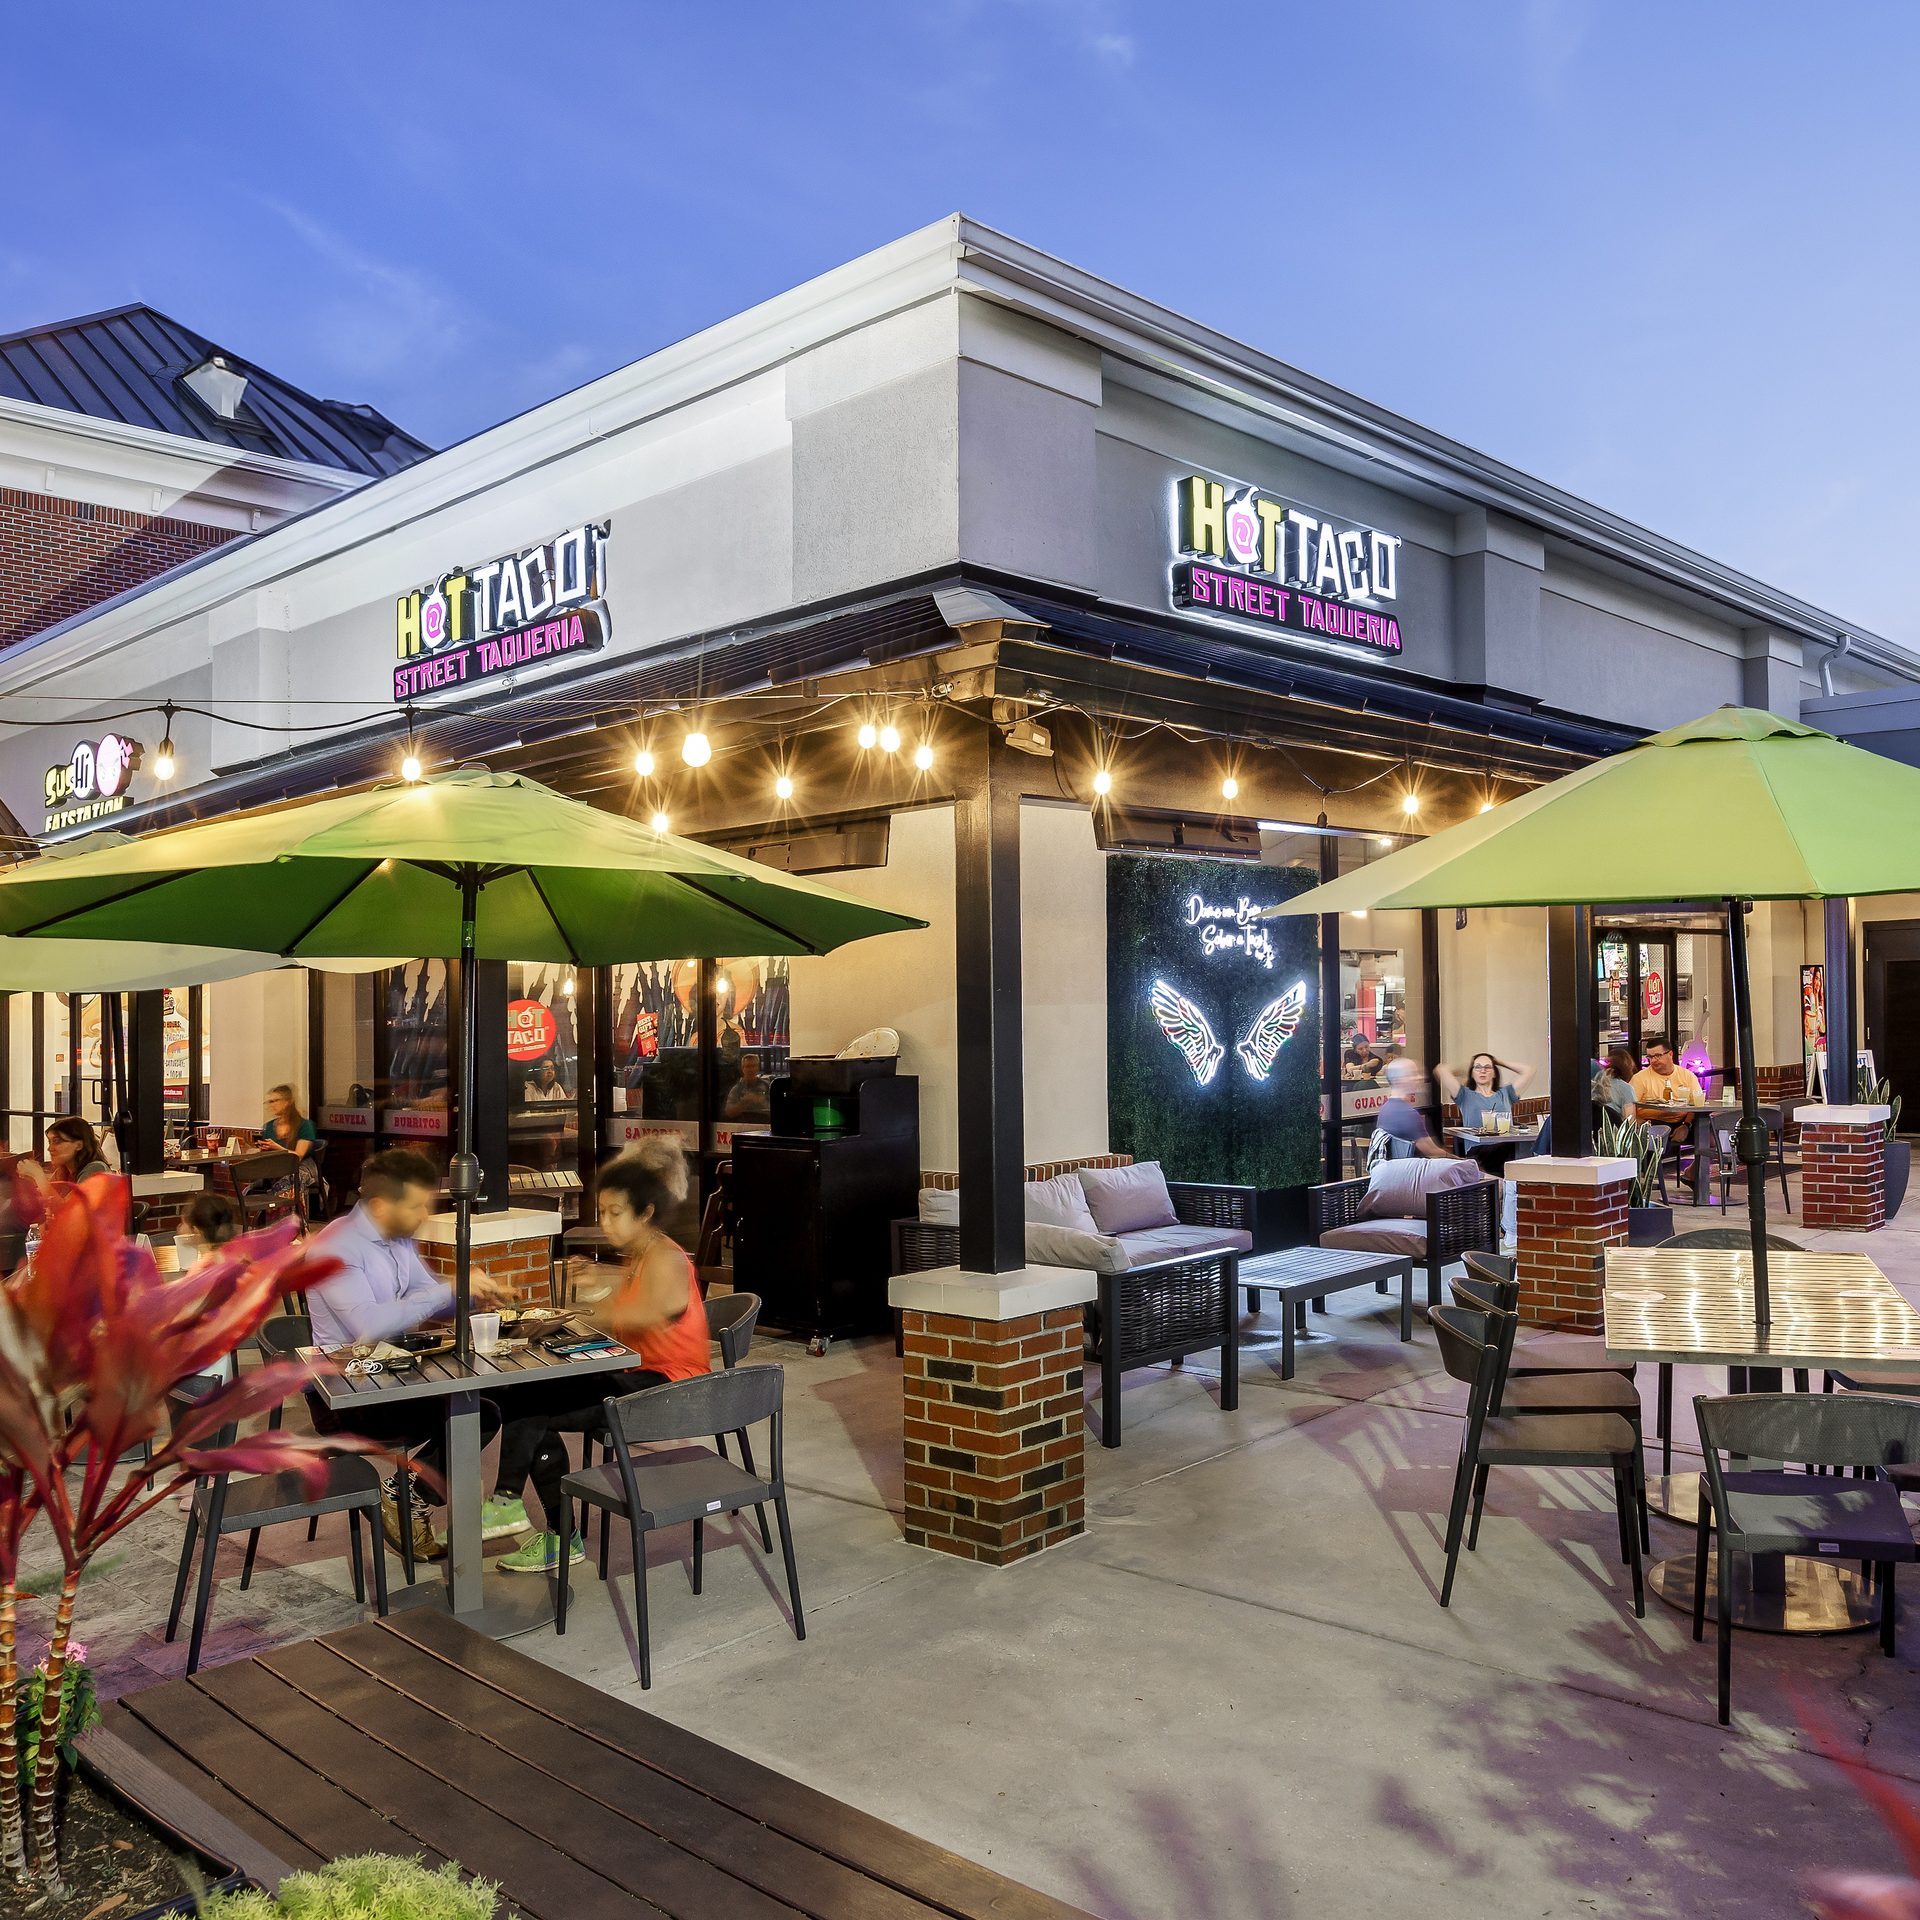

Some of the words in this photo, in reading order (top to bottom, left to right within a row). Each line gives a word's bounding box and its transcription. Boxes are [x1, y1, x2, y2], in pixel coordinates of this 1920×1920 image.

[1192, 475, 1282, 574] HOT
[1288, 509, 1397, 600] TACO
[397, 573, 467, 659] HOT
[472, 526, 588, 632] TACO
[1192, 566, 1290, 621] STREET
[1298, 596, 1400, 649] TAQUERIA
[395, 650, 470, 699] STREET
[476, 614, 585, 673] TAQUERIA
[1648, 976, 1661, 993] HOT
[508, 1028, 545, 1045] TACO
[1355, 1093, 1416, 1109] GUACAE
[329, 1113, 367, 1125] CERVEZA
[394, 1116, 441, 1129] BURRITOS
